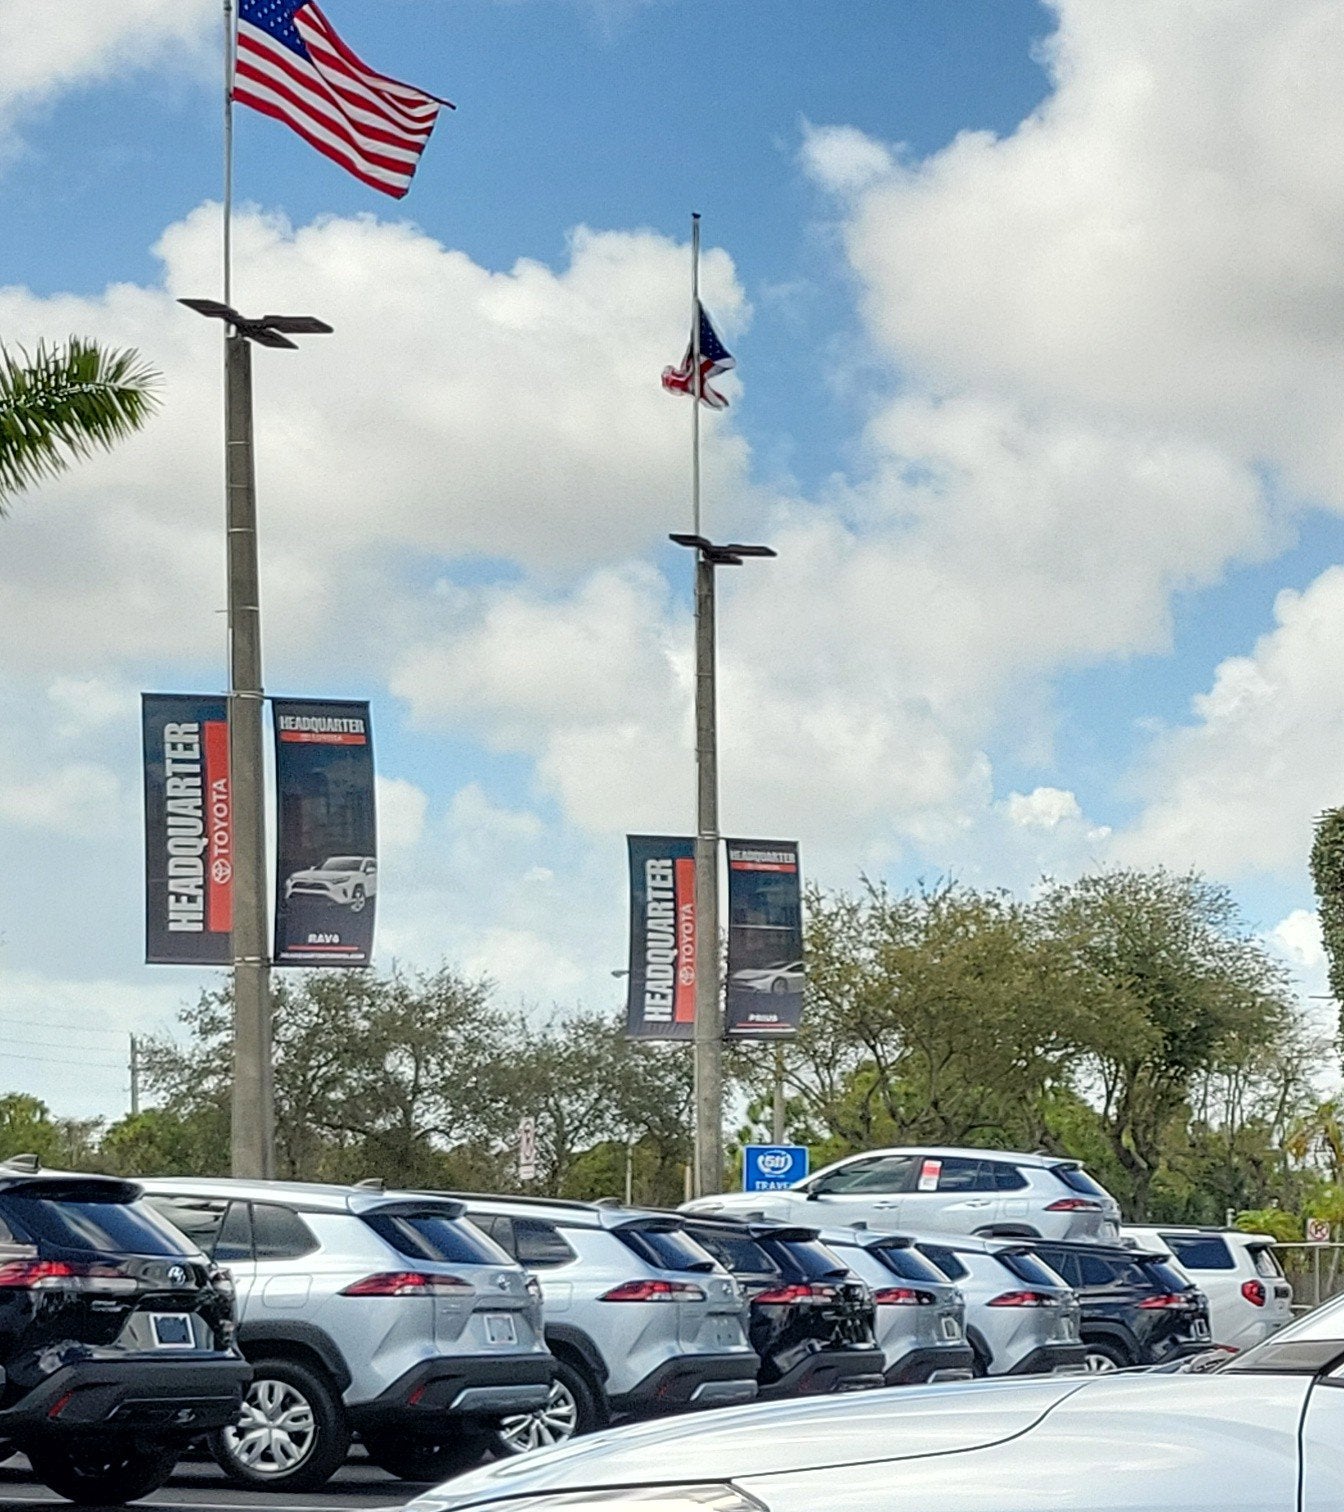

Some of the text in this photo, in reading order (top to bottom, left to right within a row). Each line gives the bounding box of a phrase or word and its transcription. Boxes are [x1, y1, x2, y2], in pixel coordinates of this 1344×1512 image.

[279, 715, 365, 733] HEADQUARTER
[164, 721, 208, 932] HEADQUARTER
[212, 777, 230, 855] TOYOTA
[644, 858, 678, 1022] HEADQUARTER
[681, 903, 695, 964] TOYOTA
